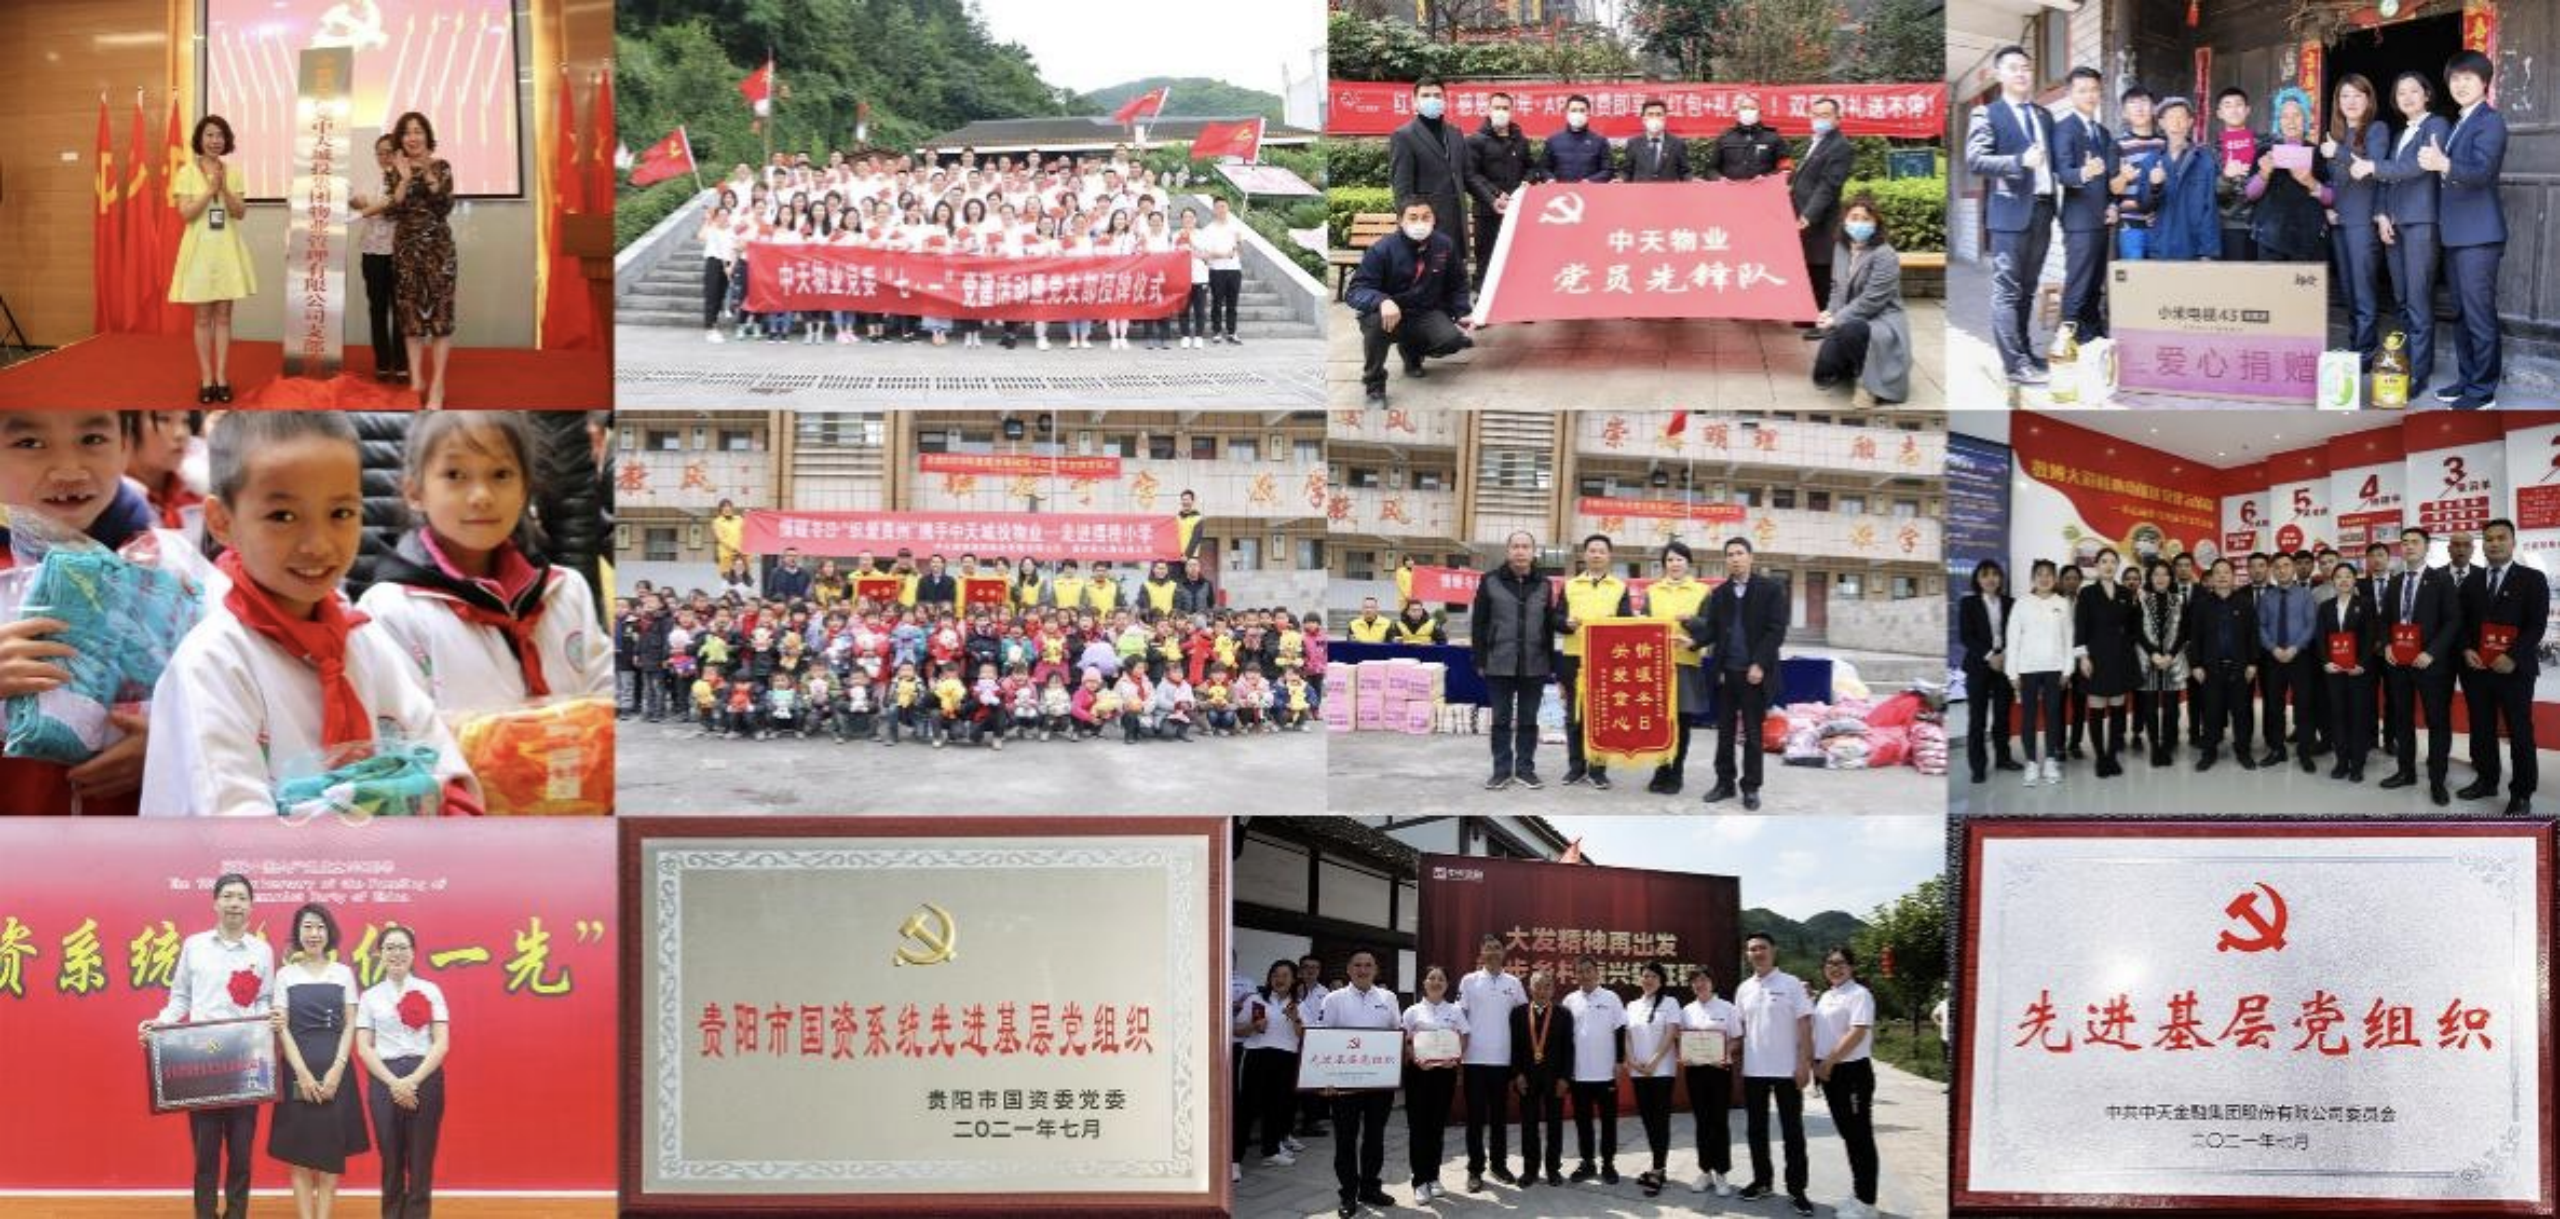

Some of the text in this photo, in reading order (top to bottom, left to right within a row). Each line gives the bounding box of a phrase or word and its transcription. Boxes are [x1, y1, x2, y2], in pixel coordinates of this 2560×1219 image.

[1608, 226, 1730, 254] 中天物业
[1553, 261, 1787, 296] 党员先锋队
[2156, 345, 2317, 383] 爱心捐赠
[2443, 456, 2467, 486] 3
[2293, 487, 2312, 514] 5
[2359, 474, 2379, 499] 4
[2240, 500, 2257, 525] 6
[1506, 925, 1678, 957] 大发精神再出发
[697, 1001, 1155, 1060] 贵阳市国资系统先进基层党组织
[2014, 988, 2496, 1057] 先进基层党组织
[927, 1088, 1127, 1111] 贵阳市国资委党委
[2106, 1103, 2397, 1123] 中共中天金融集团股份有限公司委员会
